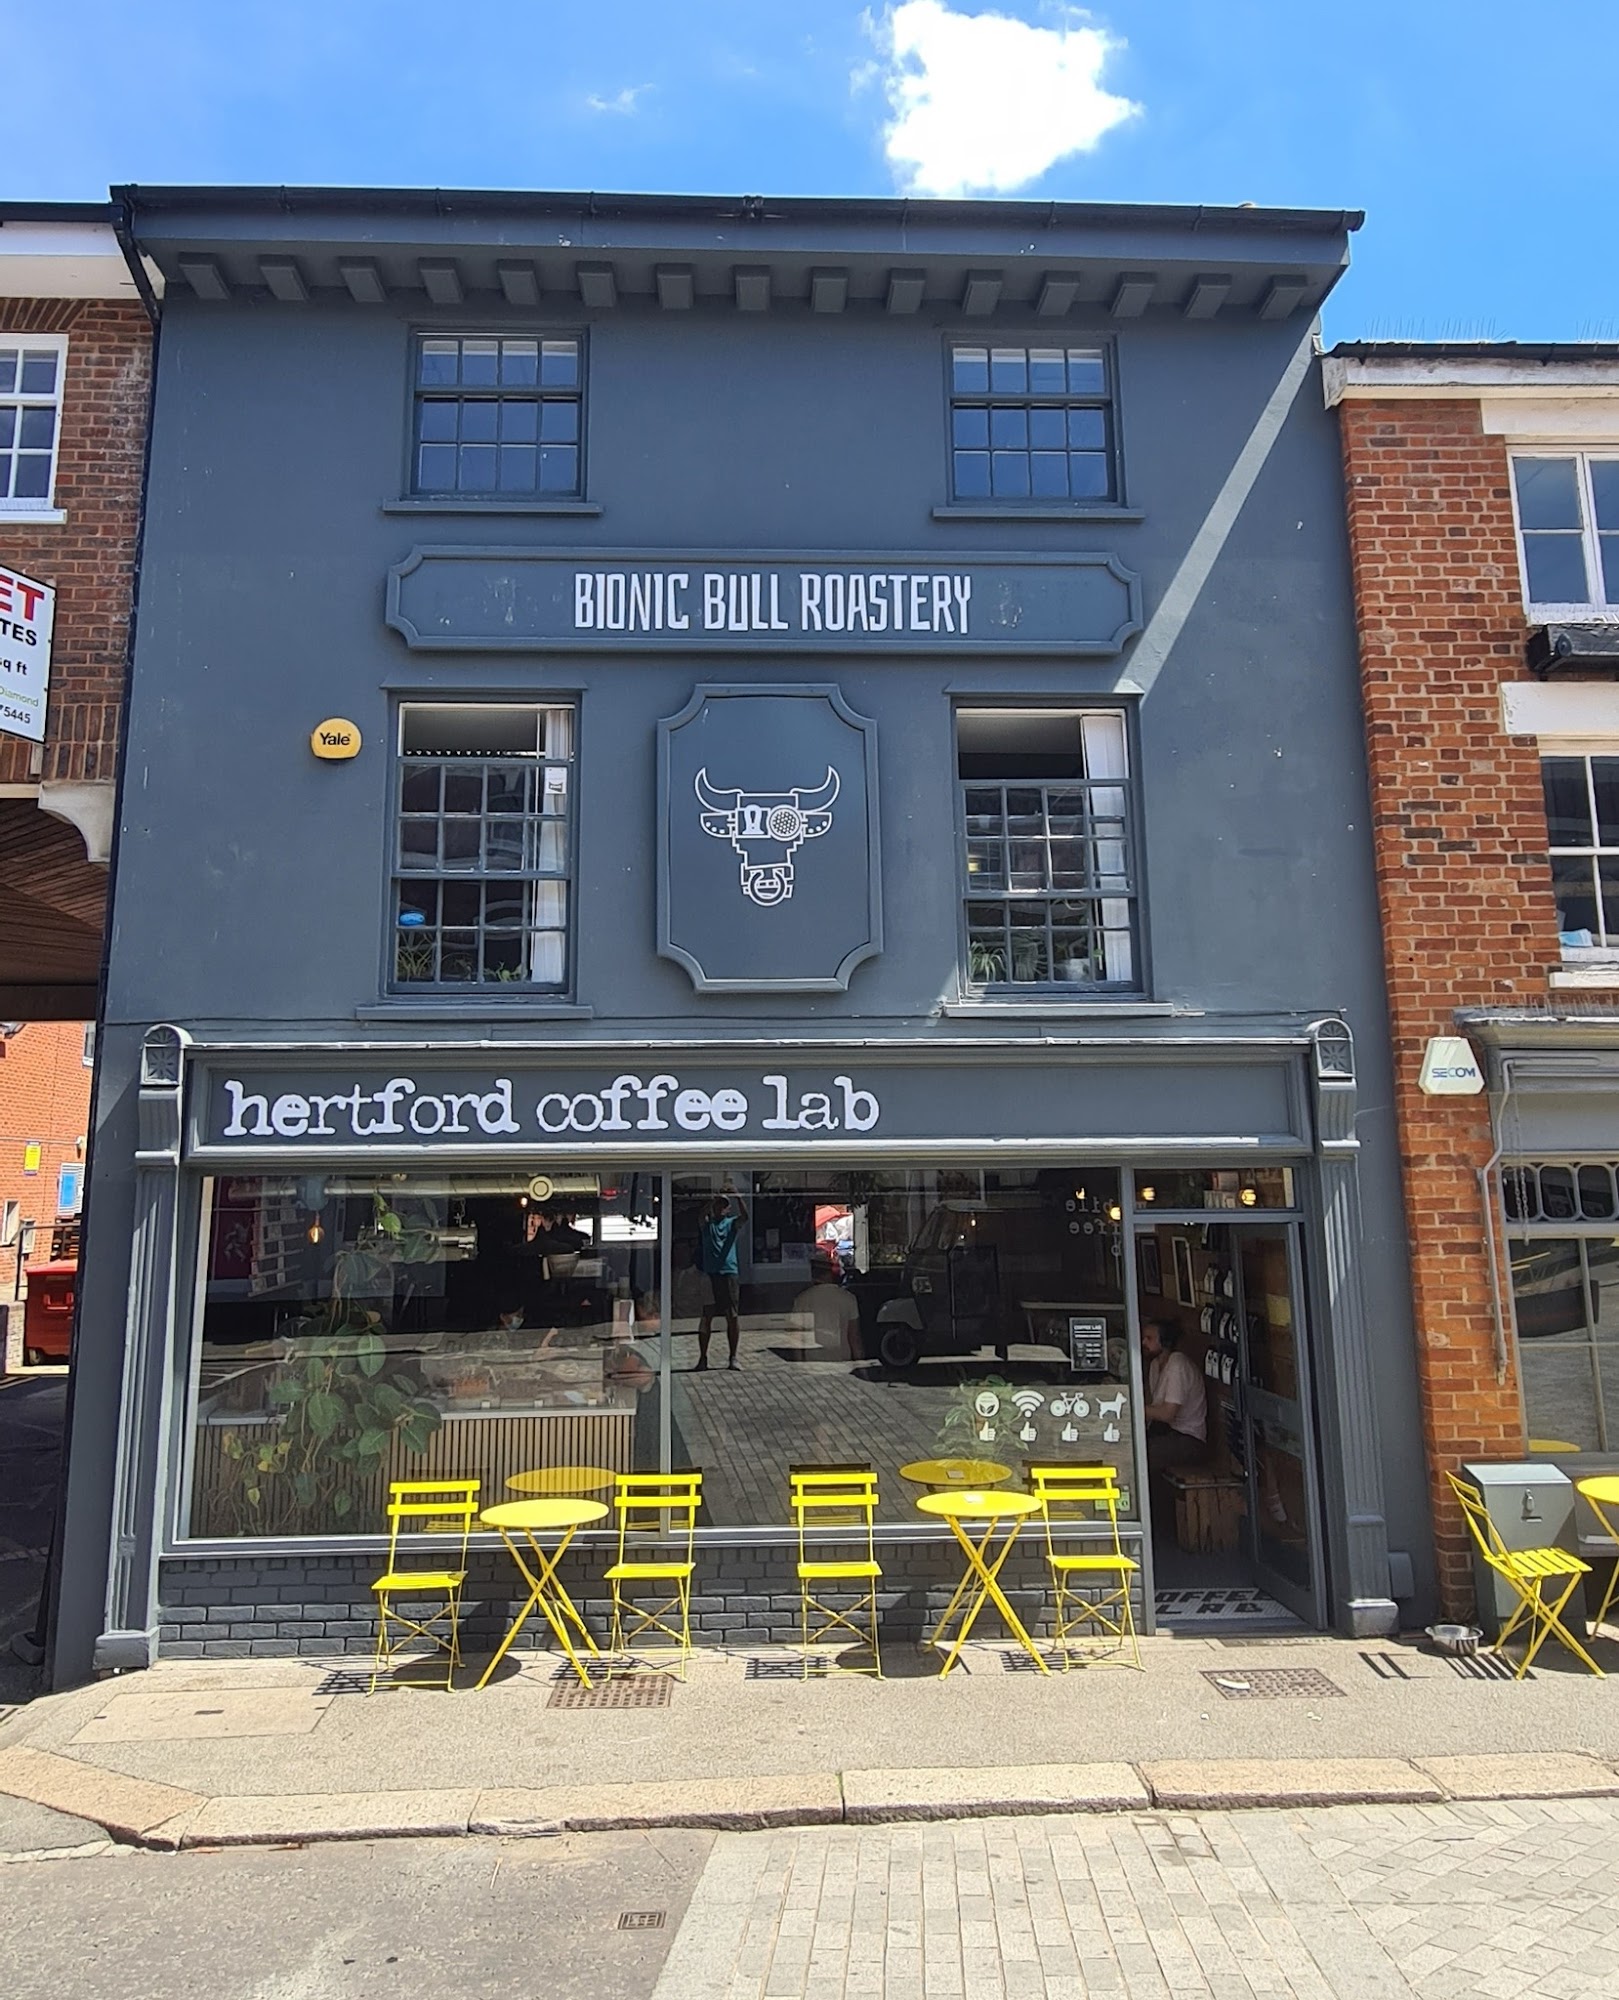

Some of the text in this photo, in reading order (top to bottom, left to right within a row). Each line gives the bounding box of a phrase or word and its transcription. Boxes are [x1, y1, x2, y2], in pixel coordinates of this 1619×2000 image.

[574, 573, 972, 634] BIONIC BULL ROASTERY
[16, 660, 28, 676] ft
[319, 731, 351, 746] Yale
[1431, 1066, 1476, 1079] SECOM
[223, 1074, 880, 1137] hertford coffee lab
[1155, 1602, 1263, 1615] LAB
